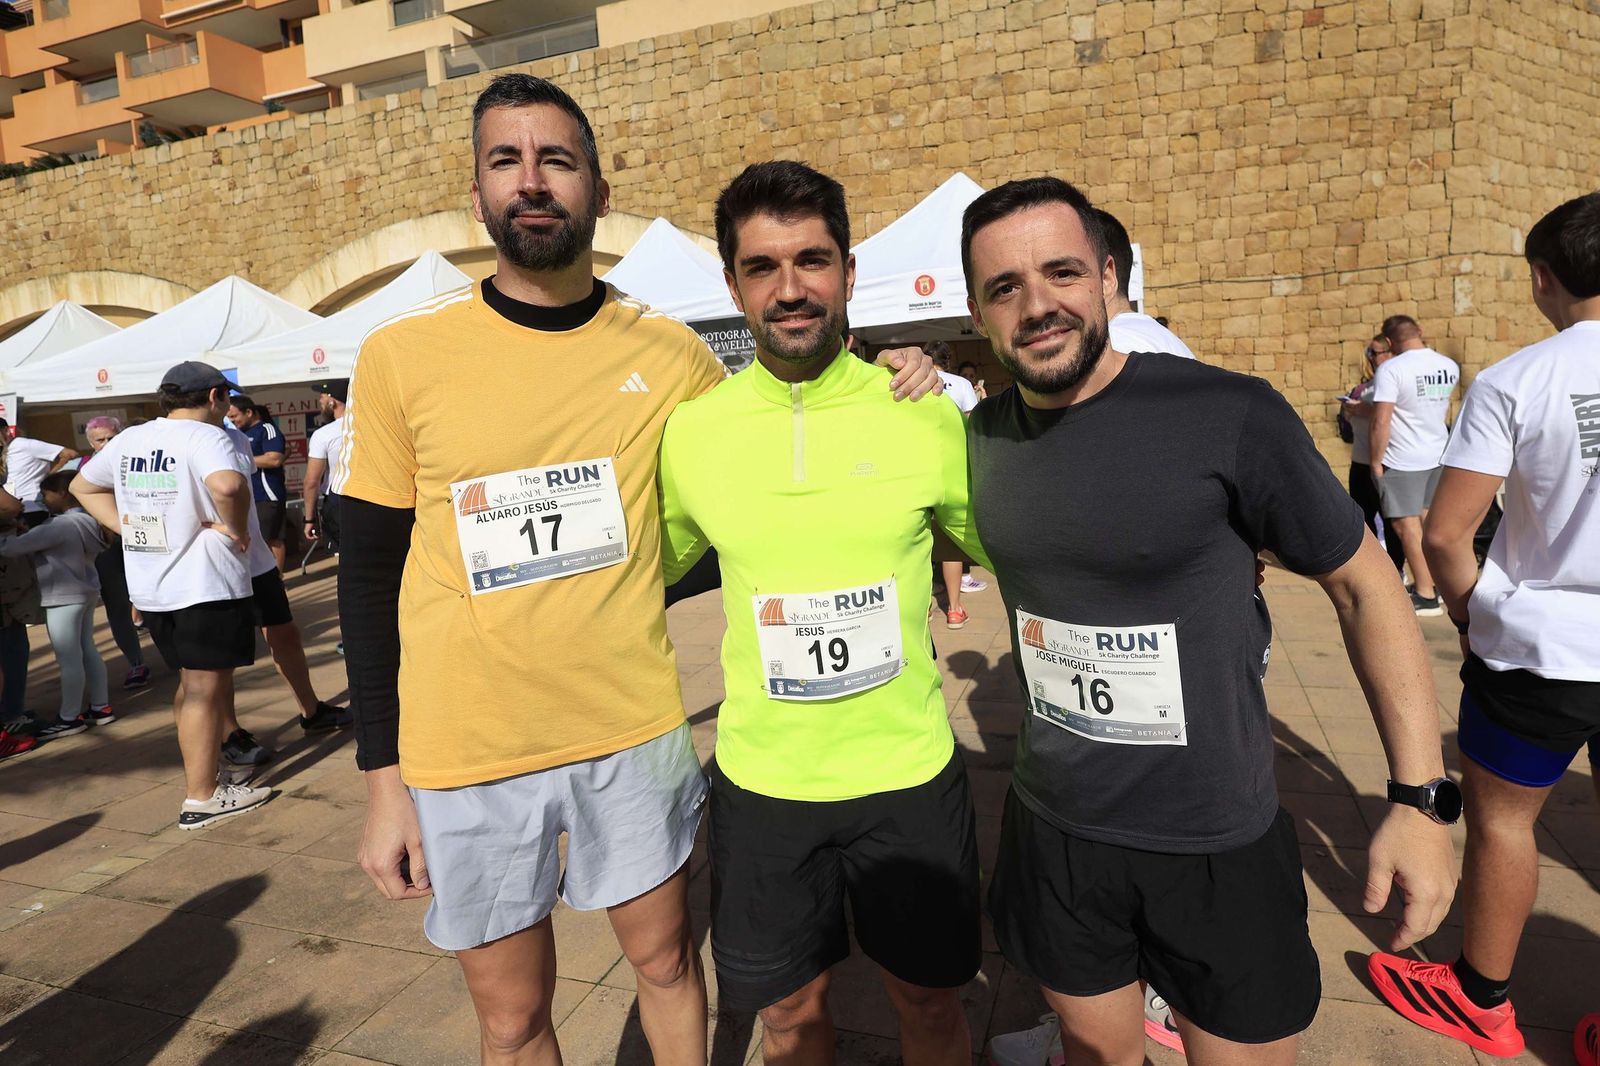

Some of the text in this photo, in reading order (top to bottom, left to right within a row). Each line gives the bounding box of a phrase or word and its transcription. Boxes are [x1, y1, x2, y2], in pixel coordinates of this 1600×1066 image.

[1570, 393, 1600, 459] EVERY
[120, 455, 129, 487] EVERY
[129, 449, 176, 472] mile
[517, 464, 600, 488] The RUN
[577, 482, 602, 490] Challenge
[524, 499, 559, 515] JESÚS
[141, 515, 159, 523] RUN
[135, 531, 148, 544] 53
[520, 514, 562, 556] 17
[808, 586, 885, 611] The RUN
[844, 608, 863, 617] Charity
[863, 603, 885, 613] Challenge
[795, 626, 825, 637] JESUS
[1067, 629, 1159, 652] The RUN
[808, 637, 850, 675] 19
[885, 650, 891, 658] M
[1036, 650, 1057, 665] JOSE
[1058, 656, 1099, 674] MIGUEL
[1107, 652, 1129, 660] Charity
[1071, 673, 1114, 715] 16
[1159, 710, 1167, 718] M
